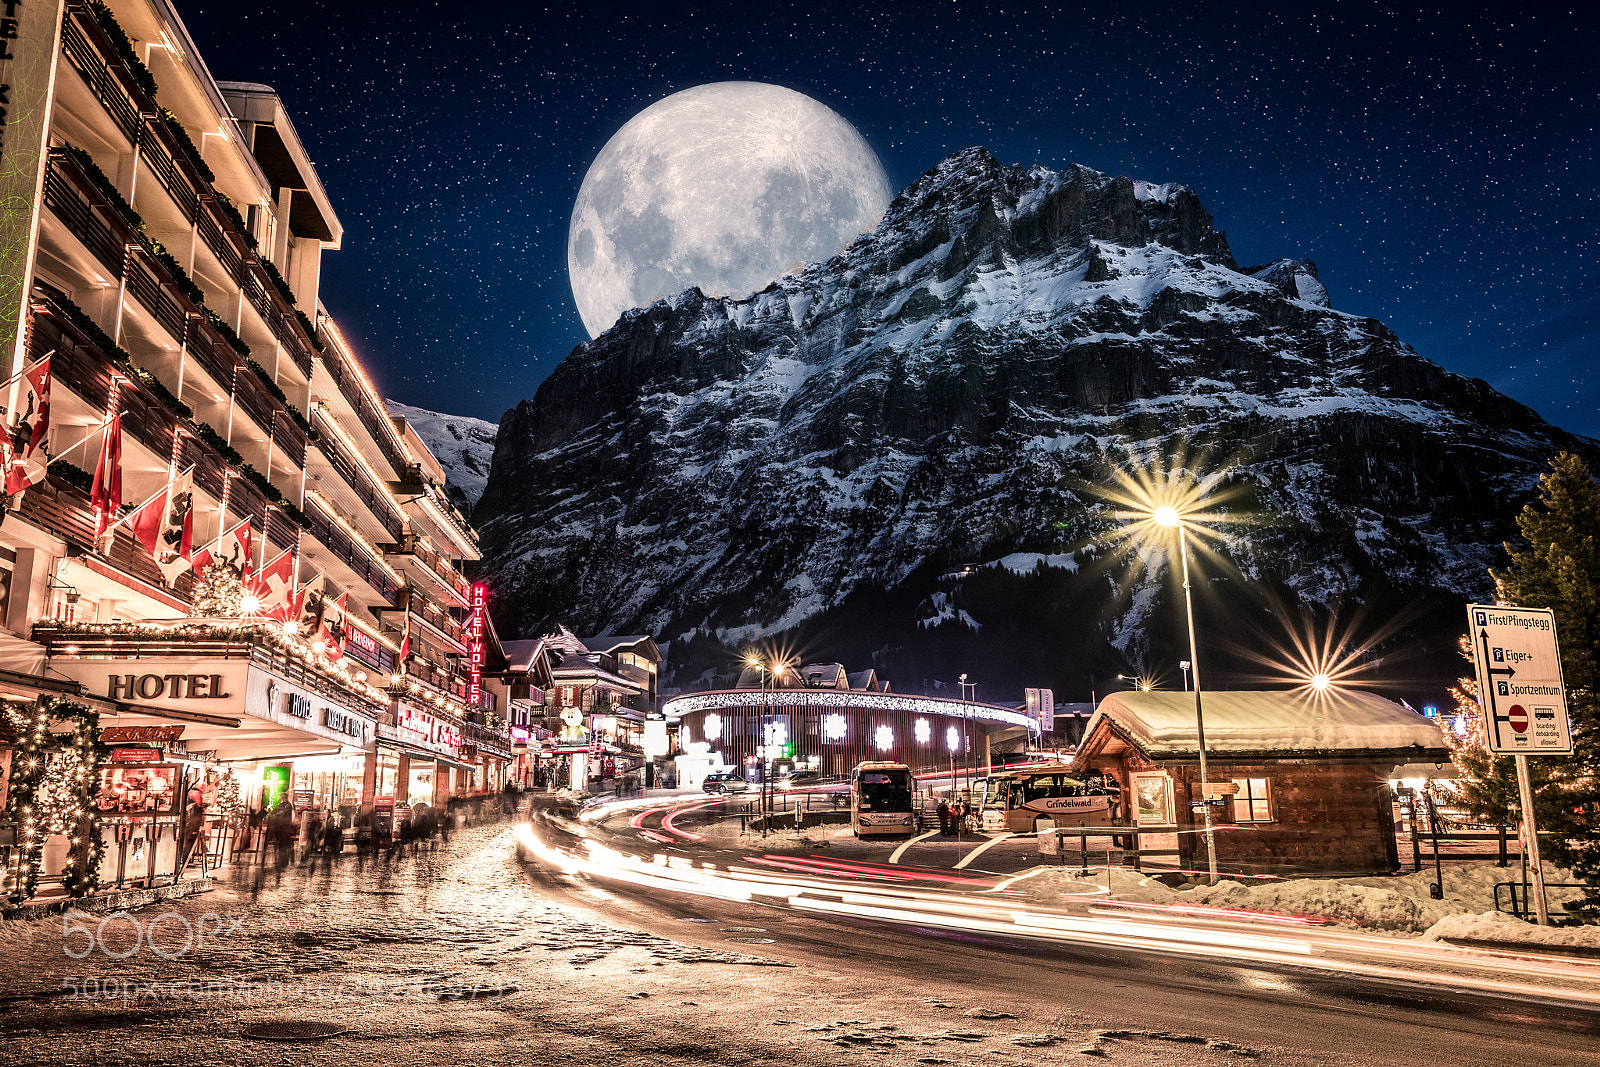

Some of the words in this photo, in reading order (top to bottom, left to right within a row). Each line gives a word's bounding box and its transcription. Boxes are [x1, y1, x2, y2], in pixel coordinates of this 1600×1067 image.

[473, 587, 483, 637] HOTEL
[1488, 614, 1550, 631] First/Pfingstegg
[1505, 649, 1533, 664] Eiger+
[470, 643, 482, 704] WOLTER
[107, 673, 230, 700] HOTEL
[1510, 684, 1561, 697] Sportzentrum
[291, 692, 312, 720] HOTEL
[1535, 730, 1560, 738] deboarding
